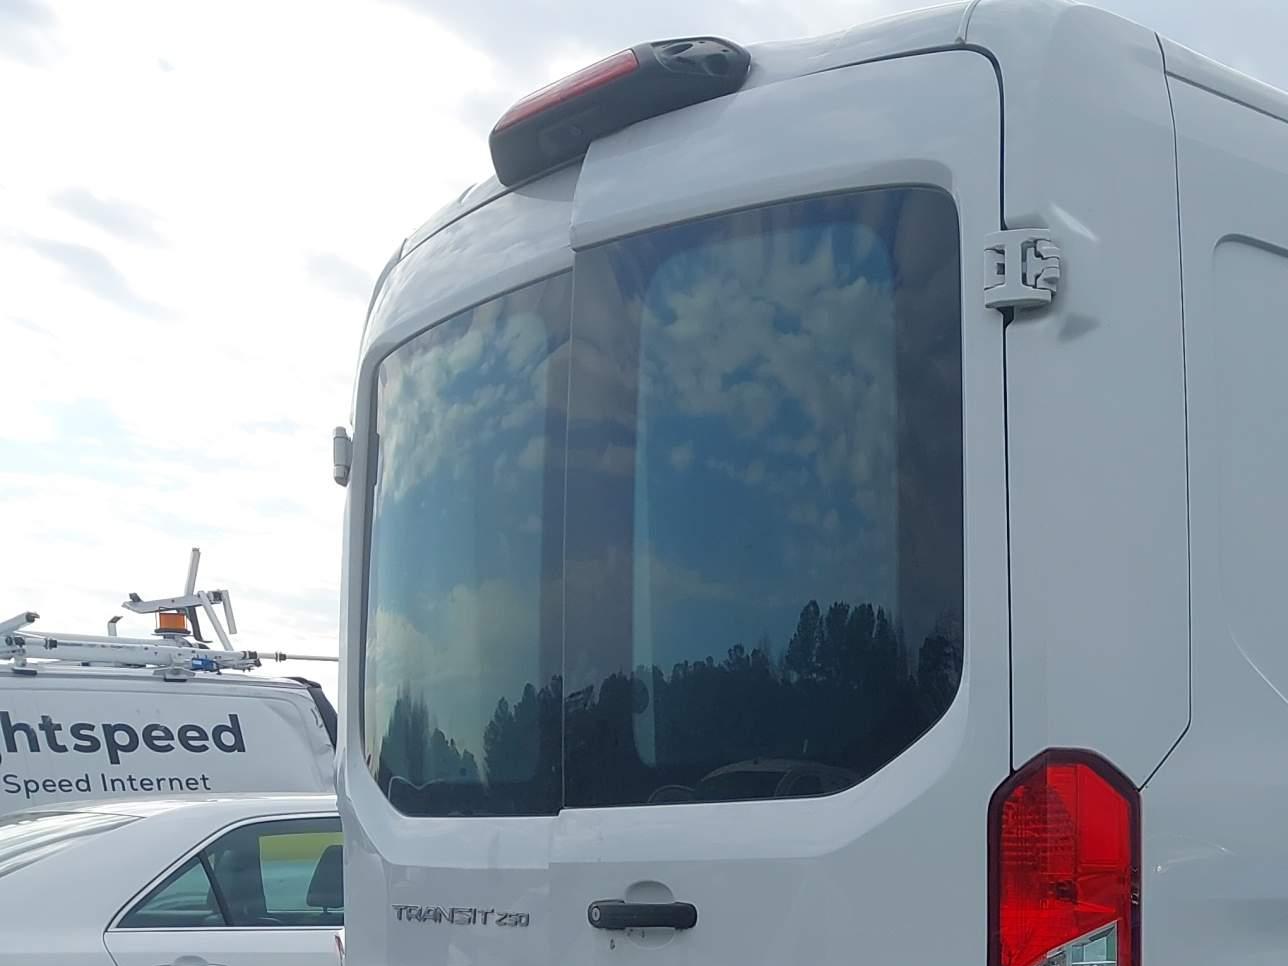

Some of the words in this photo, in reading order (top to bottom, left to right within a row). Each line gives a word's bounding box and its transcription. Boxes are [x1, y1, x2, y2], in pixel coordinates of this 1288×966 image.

[3, 773, 91, 799] Speed
[101, 773, 211, 792] Internet
[392, 904, 494, 925] TRANSIT
[495, 912, 530, 927] 250
